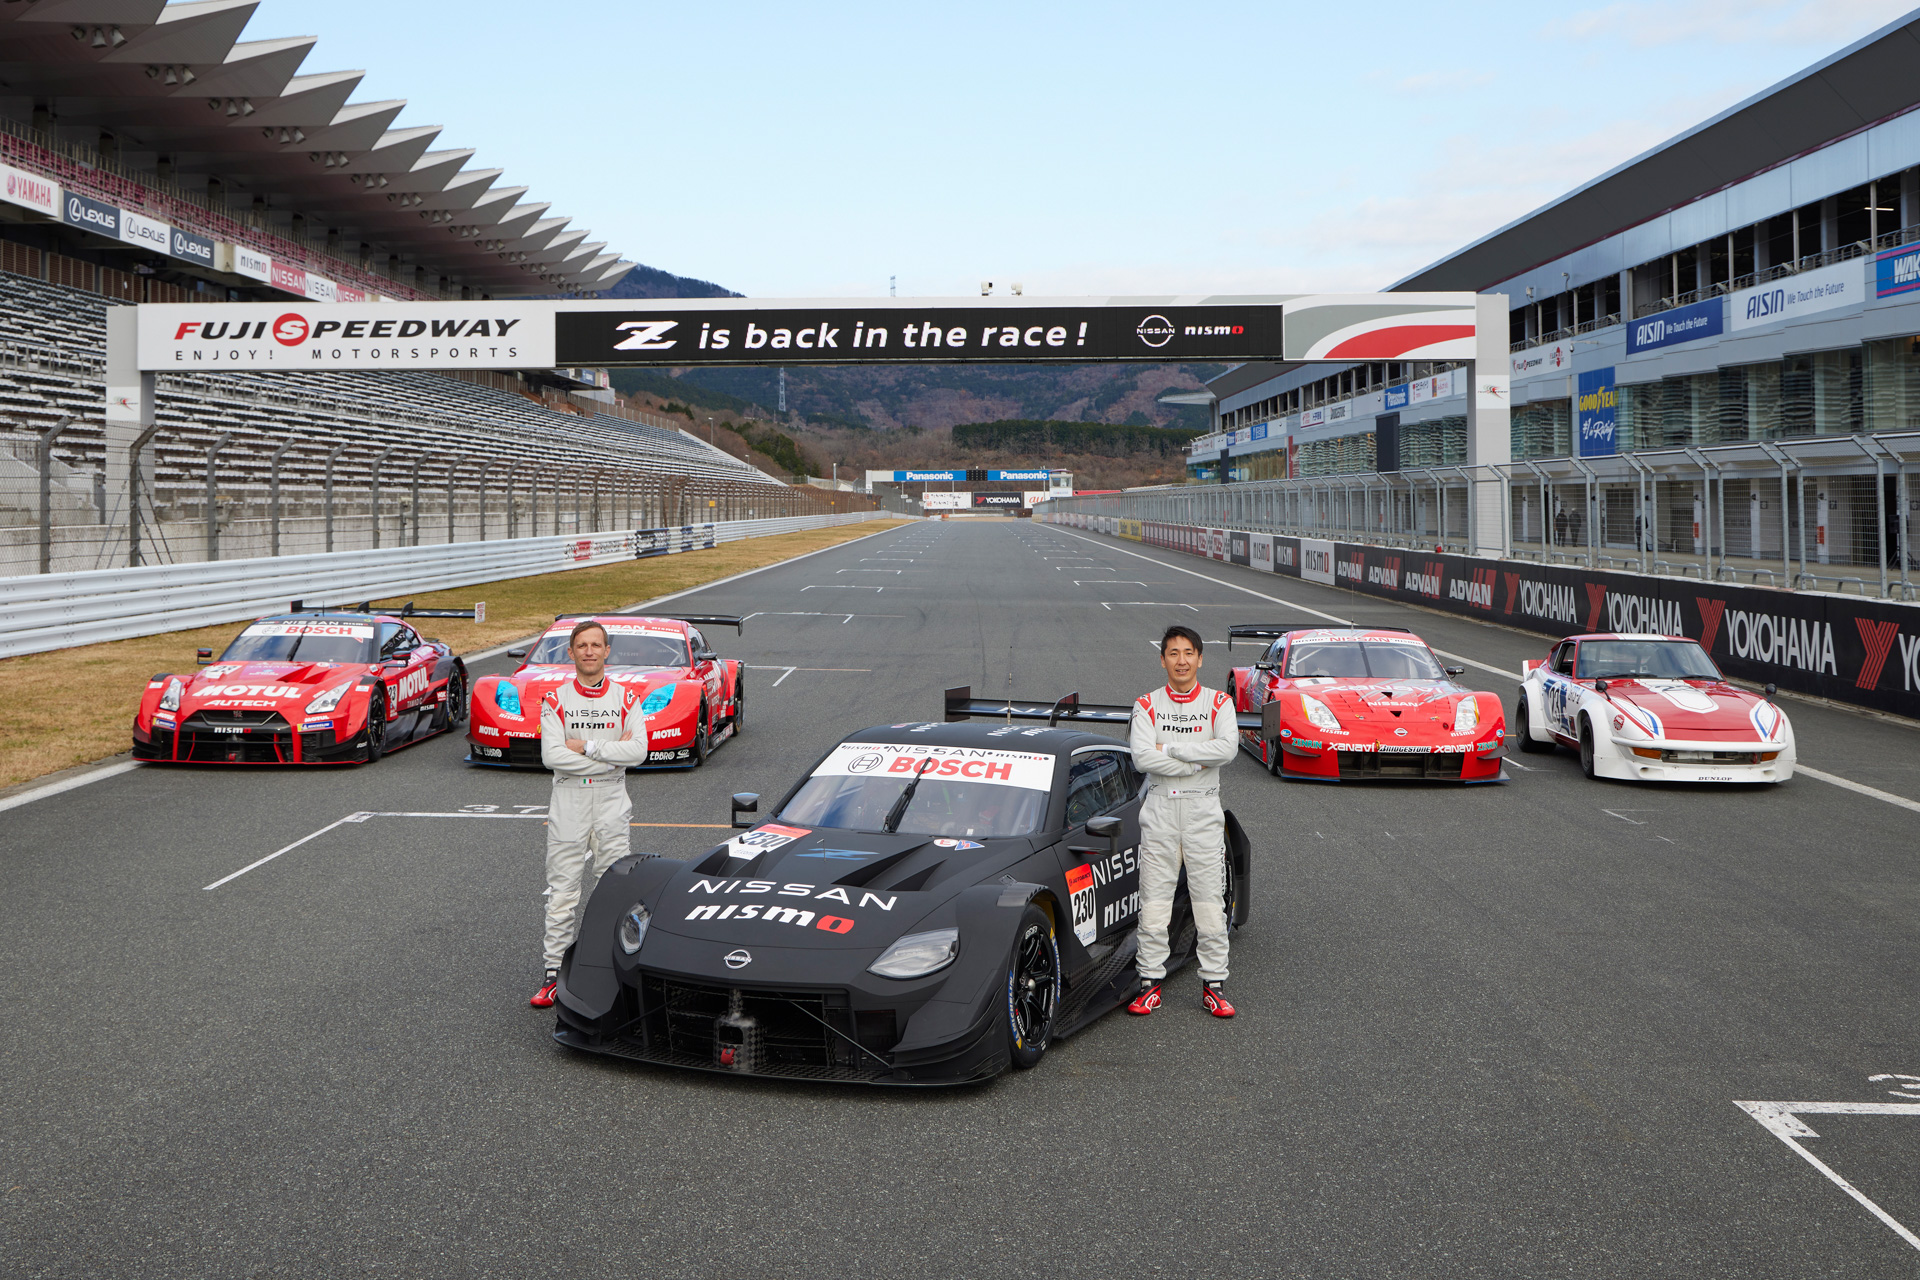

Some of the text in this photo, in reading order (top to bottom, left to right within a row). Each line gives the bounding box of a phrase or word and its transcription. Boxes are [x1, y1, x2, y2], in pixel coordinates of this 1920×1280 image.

[18, 176, 52, 208] YAMAHA
[81, 206, 115, 229] LEXUS
[137, 224, 165, 244] LEXUS
[184, 239, 211, 259] LEXUS
[272, 267, 306, 291] NISSAN
[306, 278, 337, 300] NISSAN
[1746, 282, 1845, 320] AISIN We Touch the Future
[174, 321, 265, 340] FUJI
[613, 320, 679, 350] Z
[699, 322, 731, 350] is
[744, 322, 840, 349] back
[853, 321, 888, 348] in
[902, 322, 967, 348] the
[1184, 325, 1244, 335] nismo
[1636, 317, 1708, 346] AISIN We Touch the Future
[175, 346, 518, 361] ENJOY! MOTORSPORTS
[906, 471, 954, 480] Panasonic
[1000, 471, 1047, 480] Panasonic
[1337, 560, 1362, 580] ADVAN
[1368, 566, 1397, 587] ADVAN
[1405, 571, 1440, 596] ADVAN
[1449, 578, 1491, 606] ADVAN
[1519, 580, 1577, 624] YOKOHAMA
[1606, 592, 1683, 637] YOKOHAMA
[285, 626, 352, 635] BOSCH
[1724, 608, 1838, 676] YOKOHAMA
[192, 685, 302, 698] MOTUL
[388, 685, 397, 700] 23
[398, 666, 429, 702] MOTUL
[304, 715, 330, 723] MOTUL
[565, 709, 620, 718] NISSAN
[1156, 712, 1208, 722] NISSAN
[478, 725, 500, 737] MOTUL
[503, 730, 536, 738] AUTECH
[651, 727, 682, 740] MOTUL
[1162, 725, 1203, 733] nismo
[887, 745, 986, 758] NISSAN
[996, 753, 1043, 761] nismo
[1291, 737, 1323, 750] ZENRIN
[1379, 745, 1431, 753] BRIDGESTONE
[1477, 740, 1498, 752] ZENRIN
[649, 751, 675, 761] EBBRO
[887, 756, 1013, 781] BOSCH
[688, 879, 898, 911] NISSAN
[1073, 887, 1094, 927] 230
[684, 904, 855, 935] nismo
[723, 955, 753, 963] NISSAN
[1008, 976, 1017, 1033] MICHELIN
